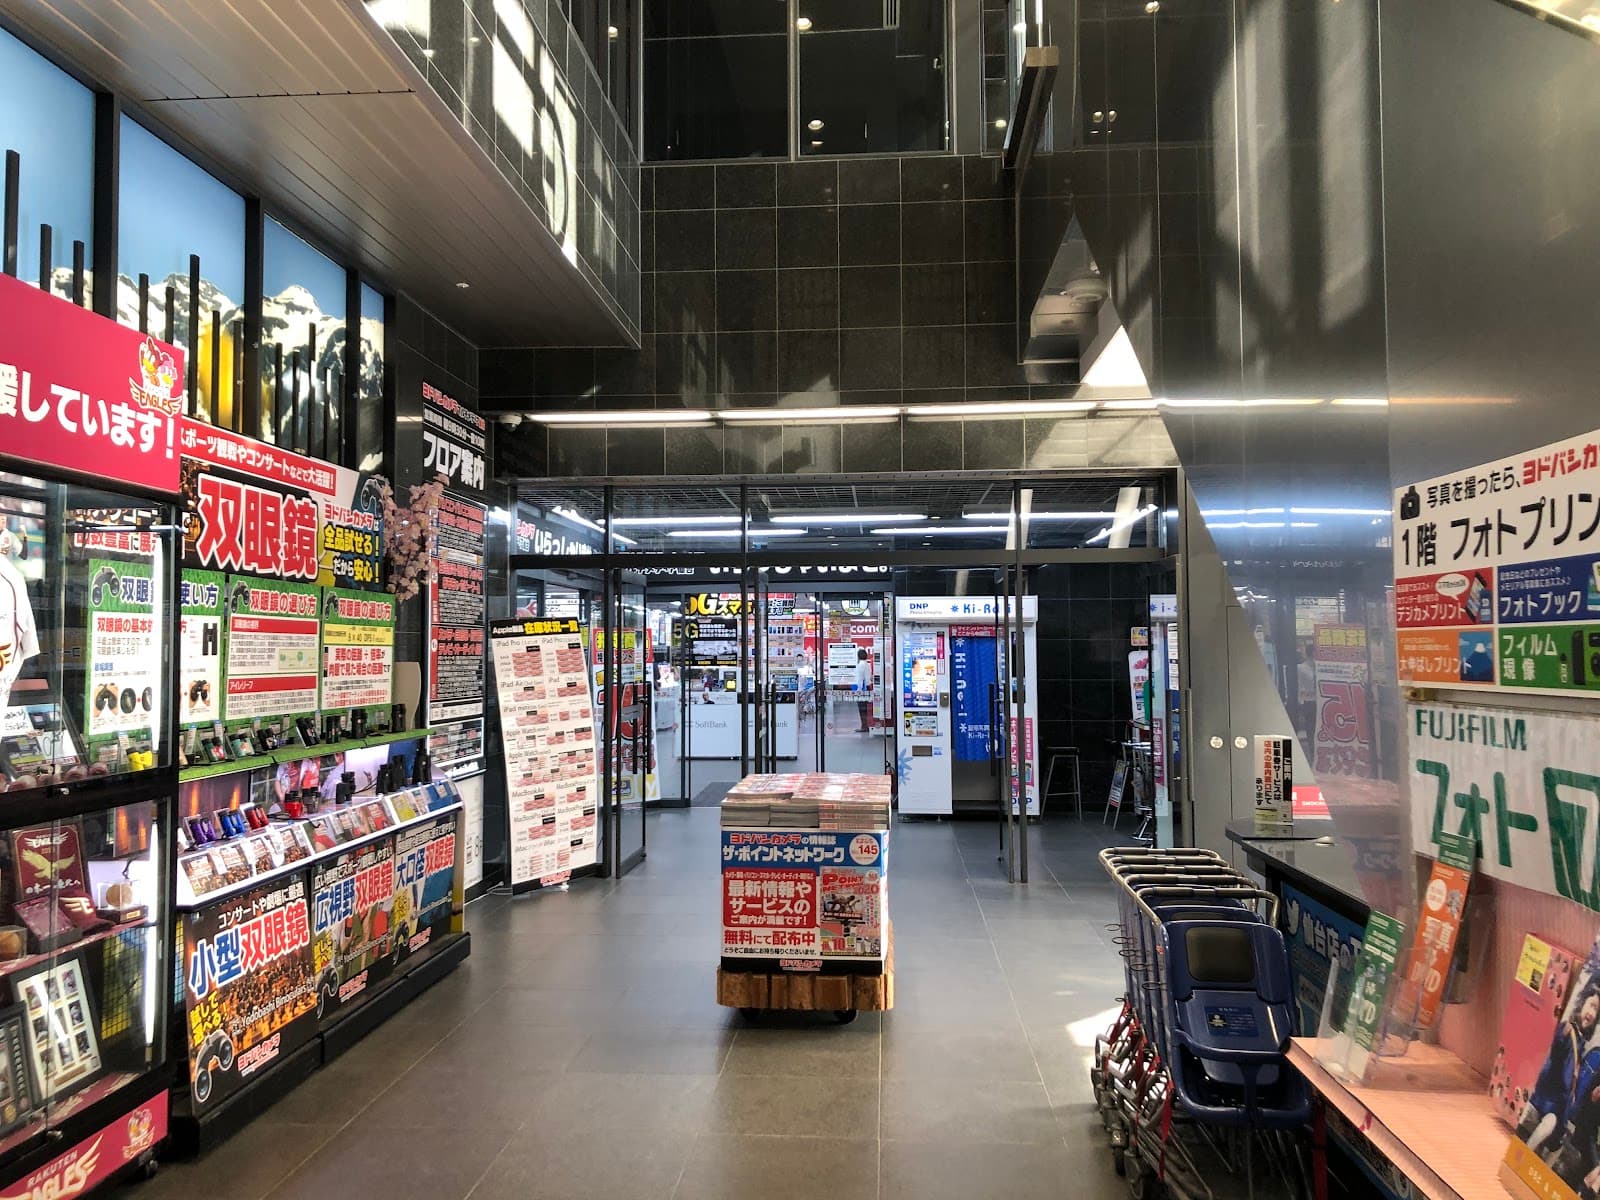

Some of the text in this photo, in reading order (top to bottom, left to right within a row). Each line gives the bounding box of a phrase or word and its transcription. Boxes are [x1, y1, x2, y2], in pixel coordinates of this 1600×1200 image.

[423, 430, 485, 491] フロア案内
[197, 472, 319, 580] 双眼鏡
[1402, 522, 1437, 568] 1階
[250, 589, 317, 616] 双眼鏡の選び方
[338, 597, 393, 622] 双眼鏡の選び方
[909, 602, 929, 610] DNP
[1396, 602, 1467, 623] デジカメプリント
[1500, 591, 1583, 619] フォトブック
[1503, 633, 1559, 656] フィルム
[695, 720, 727, 729] SoftBank
[1415, 708, 1529, 751] FUJIFILM
[396, 832, 456, 892] 大口径双眼鏡
[722, 845, 845, 863] ザ・ポイントネットワーク
[858, 844, 878, 855] 145
[314, 858, 394, 936] 広視野双眼鏡
[728, 879, 813, 900] 最新情報や
[729, 899, 811, 915] サービスの
[188, 899, 311, 999] 小型双眼鏡
[724, 930, 816, 946] 無料にて配布中
